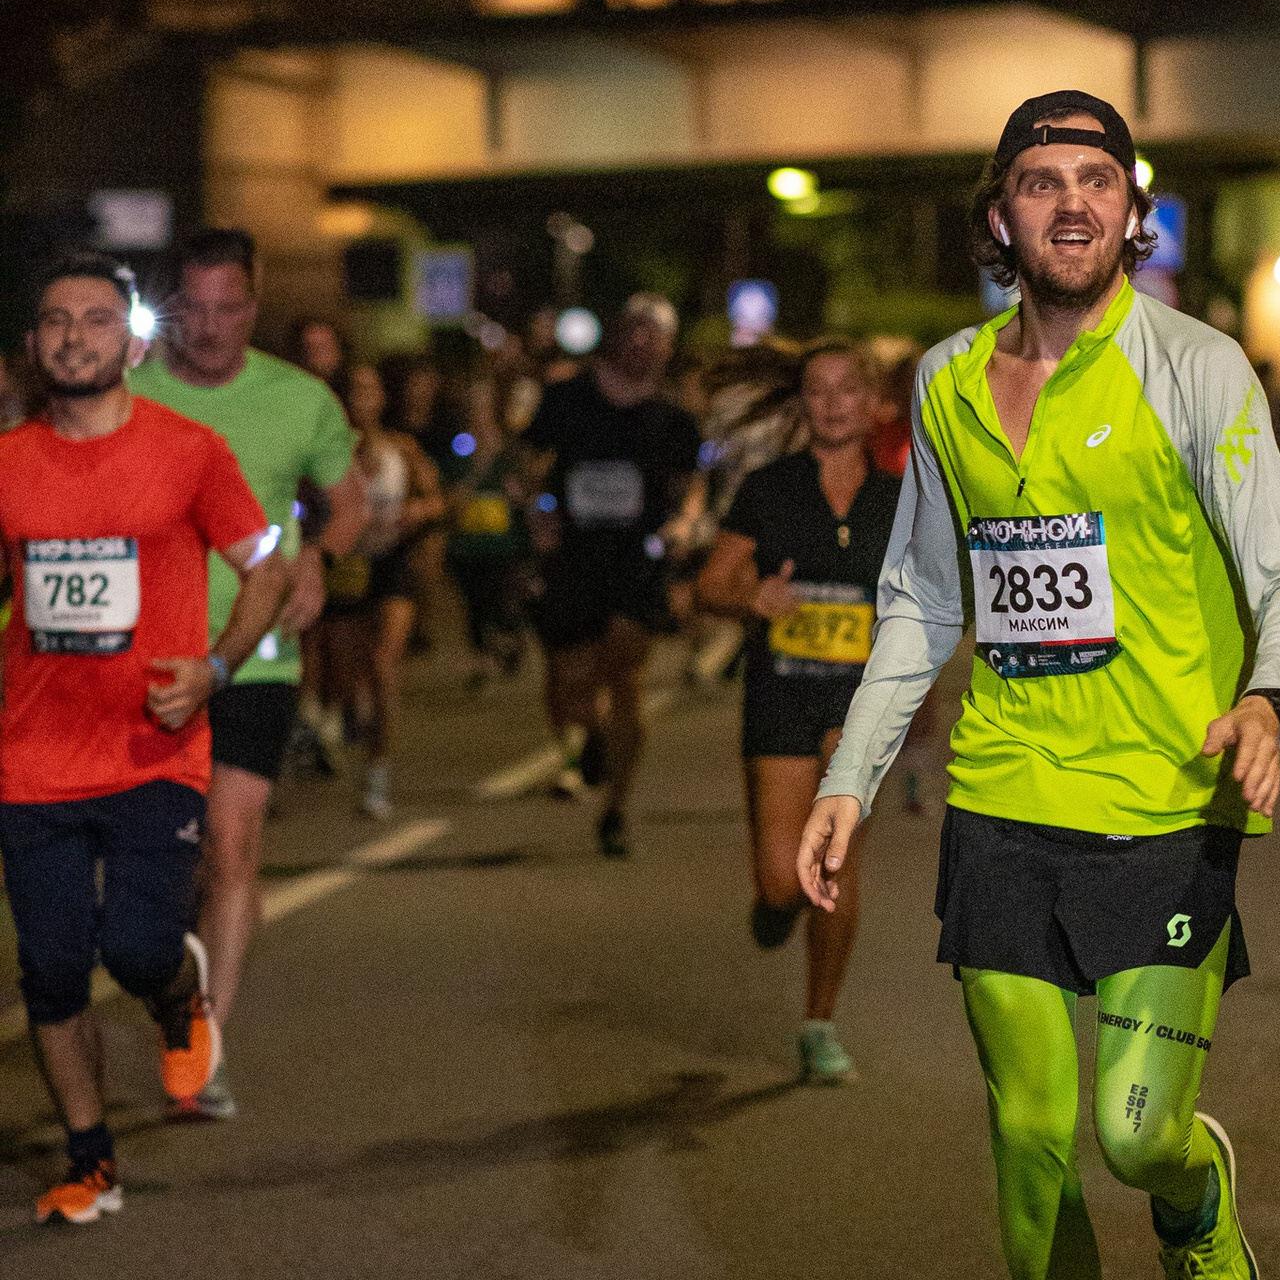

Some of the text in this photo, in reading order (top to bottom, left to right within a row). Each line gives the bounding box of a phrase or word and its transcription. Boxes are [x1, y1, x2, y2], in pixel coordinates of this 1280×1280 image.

[43, 573, 109, 608] 782
[989, 562, 1093, 613] 2833
[1008, 616, 1069, 632] МАКСИМ
[1156, 1025, 1196, 1046] CLUB
